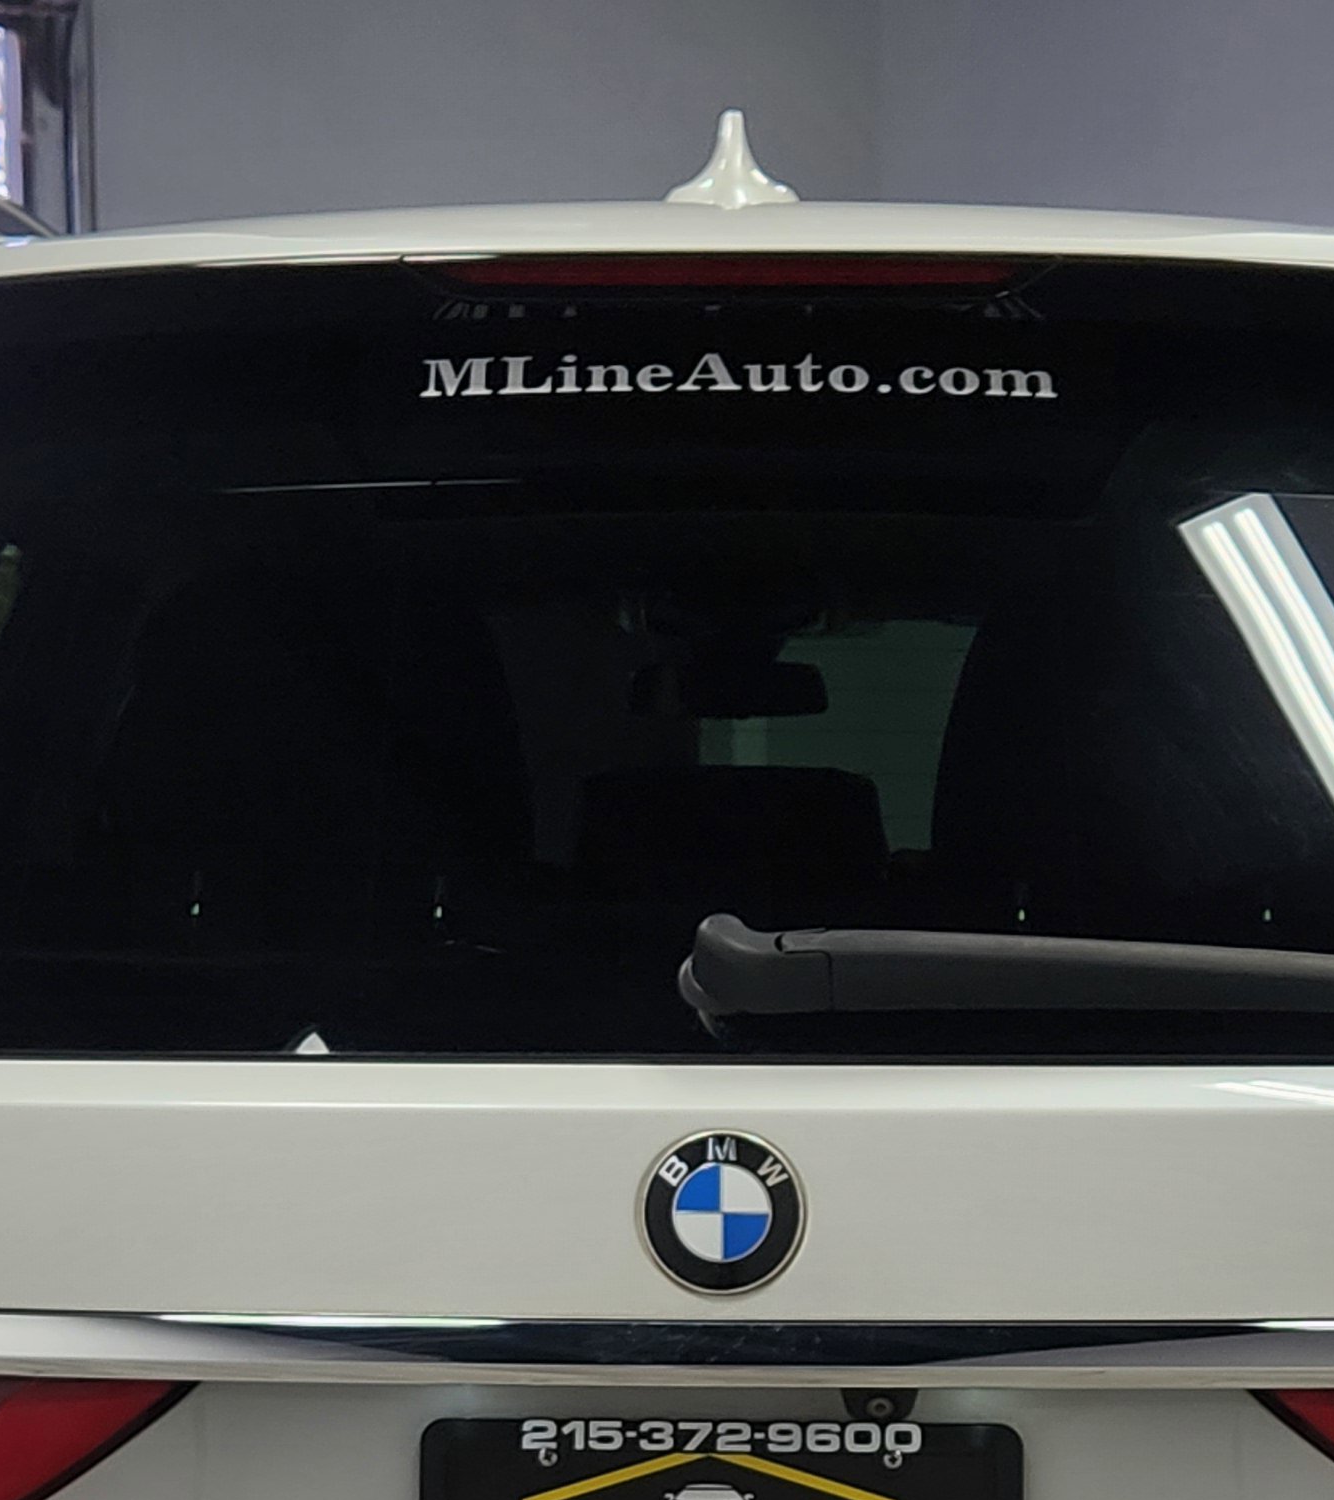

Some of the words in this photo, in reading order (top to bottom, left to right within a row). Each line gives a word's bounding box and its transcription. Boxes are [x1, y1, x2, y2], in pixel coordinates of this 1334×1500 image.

[419, 353, 1058, 399] MLineAuto.com
[658, 1136, 789, 1188] BMW
[520, 1419, 922, 1453] 215-372-9600
